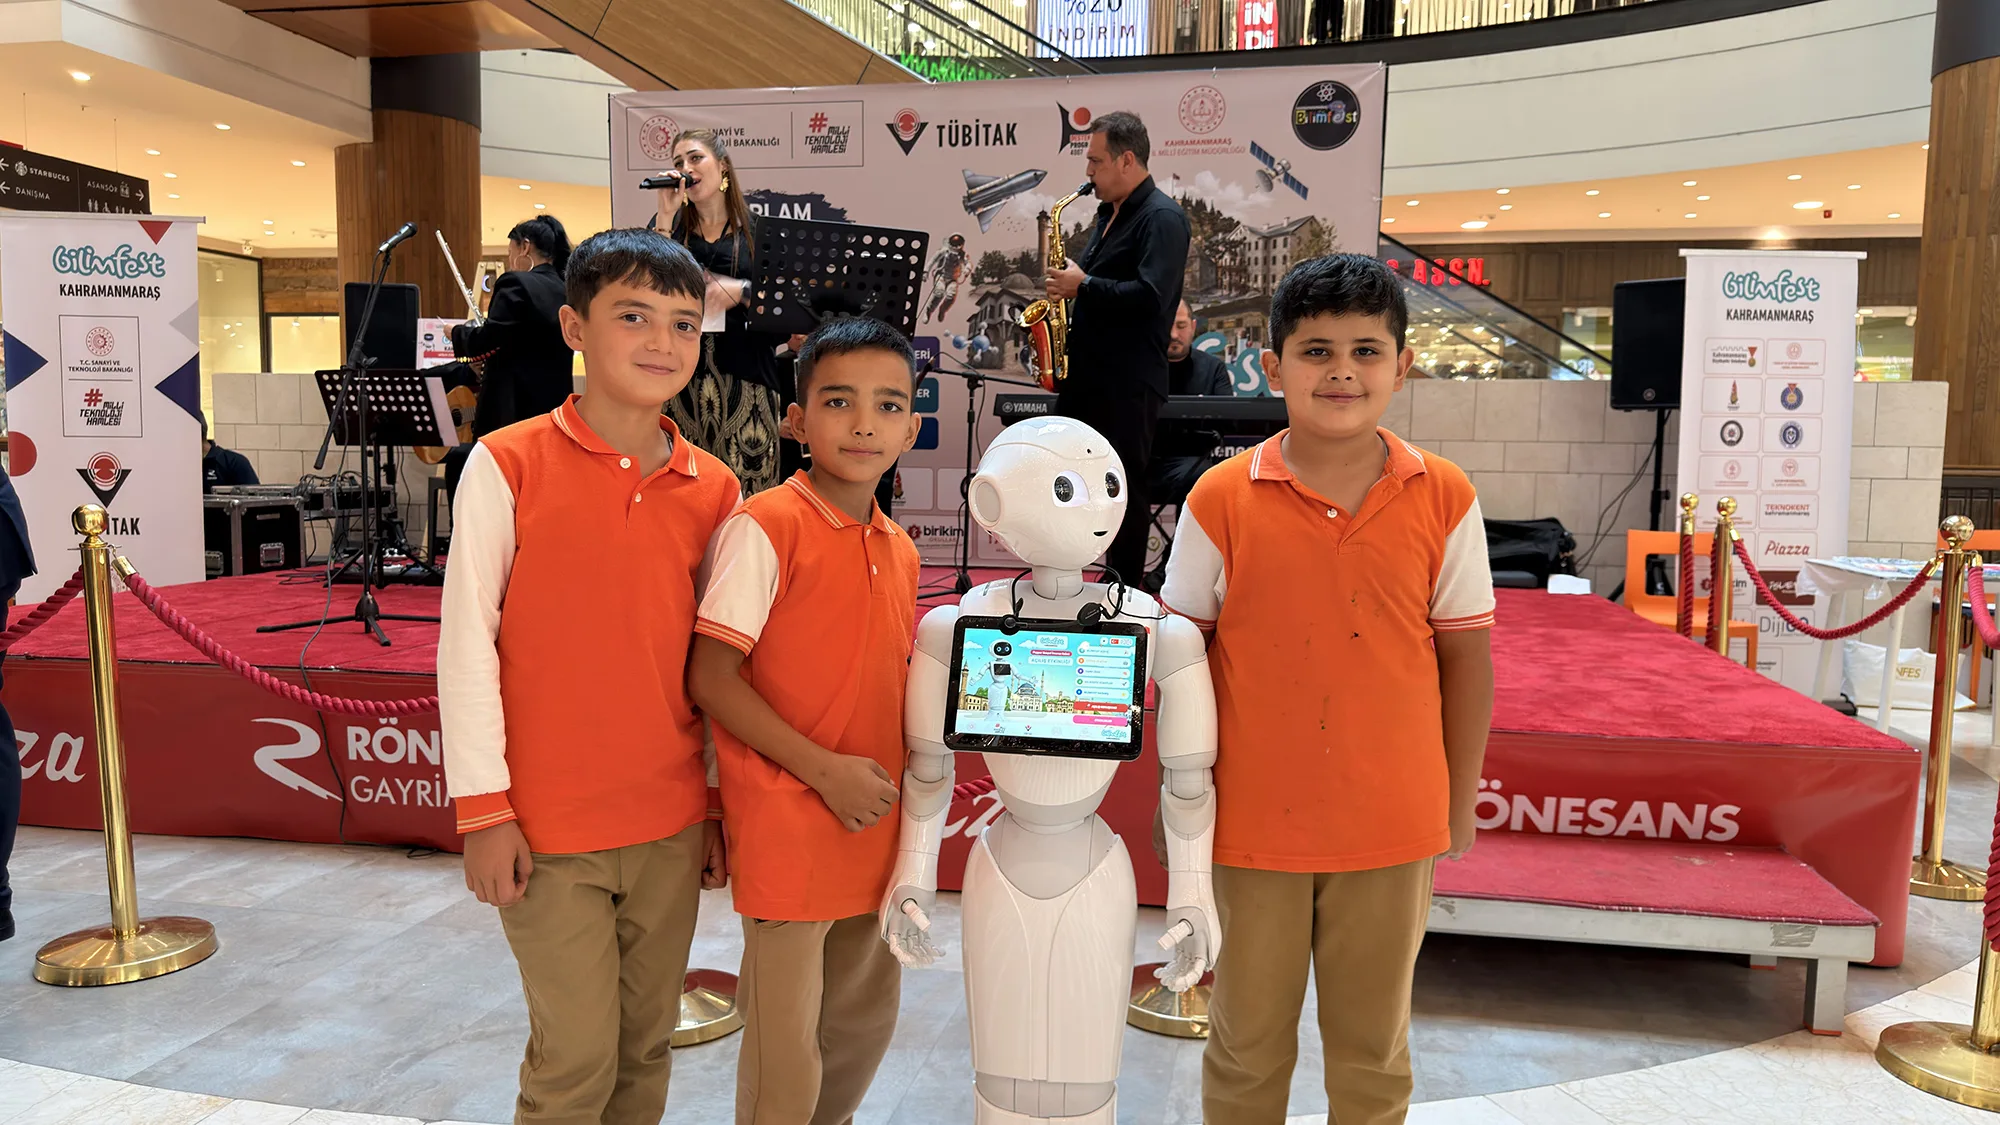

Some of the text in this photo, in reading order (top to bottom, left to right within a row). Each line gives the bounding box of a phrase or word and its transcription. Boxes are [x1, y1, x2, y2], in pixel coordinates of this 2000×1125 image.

[1049, 21, 1135, 42] İNDİRİM
[711, 127, 745, 136] NAYİ VE
[936, 119, 1018, 148] TÜBİTAK
[733, 137, 780, 147] BAKANLIĞI
[1164, 138, 1232, 147] KAHRAMANMARAŞ
[29, 167, 71, 182] STARBUCKS
[86, 181, 119, 193] ASANSÖR
[59, 283, 161, 301] KAHRAMANMARAŞ
[1726, 308, 1814, 324] KAHRAMANMARAŞ
[914, 348, 931, 360] ERİ
[1013, 402, 1048, 413] YAMAHA
[923, 525, 965, 537] birikim
[1764, 539, 1811, 556] Piazza
[346, 717, 441, 766] RÖN
[13, 729, 88, 784] za
[1474, 778, 1742, 842] ÖNESANS
